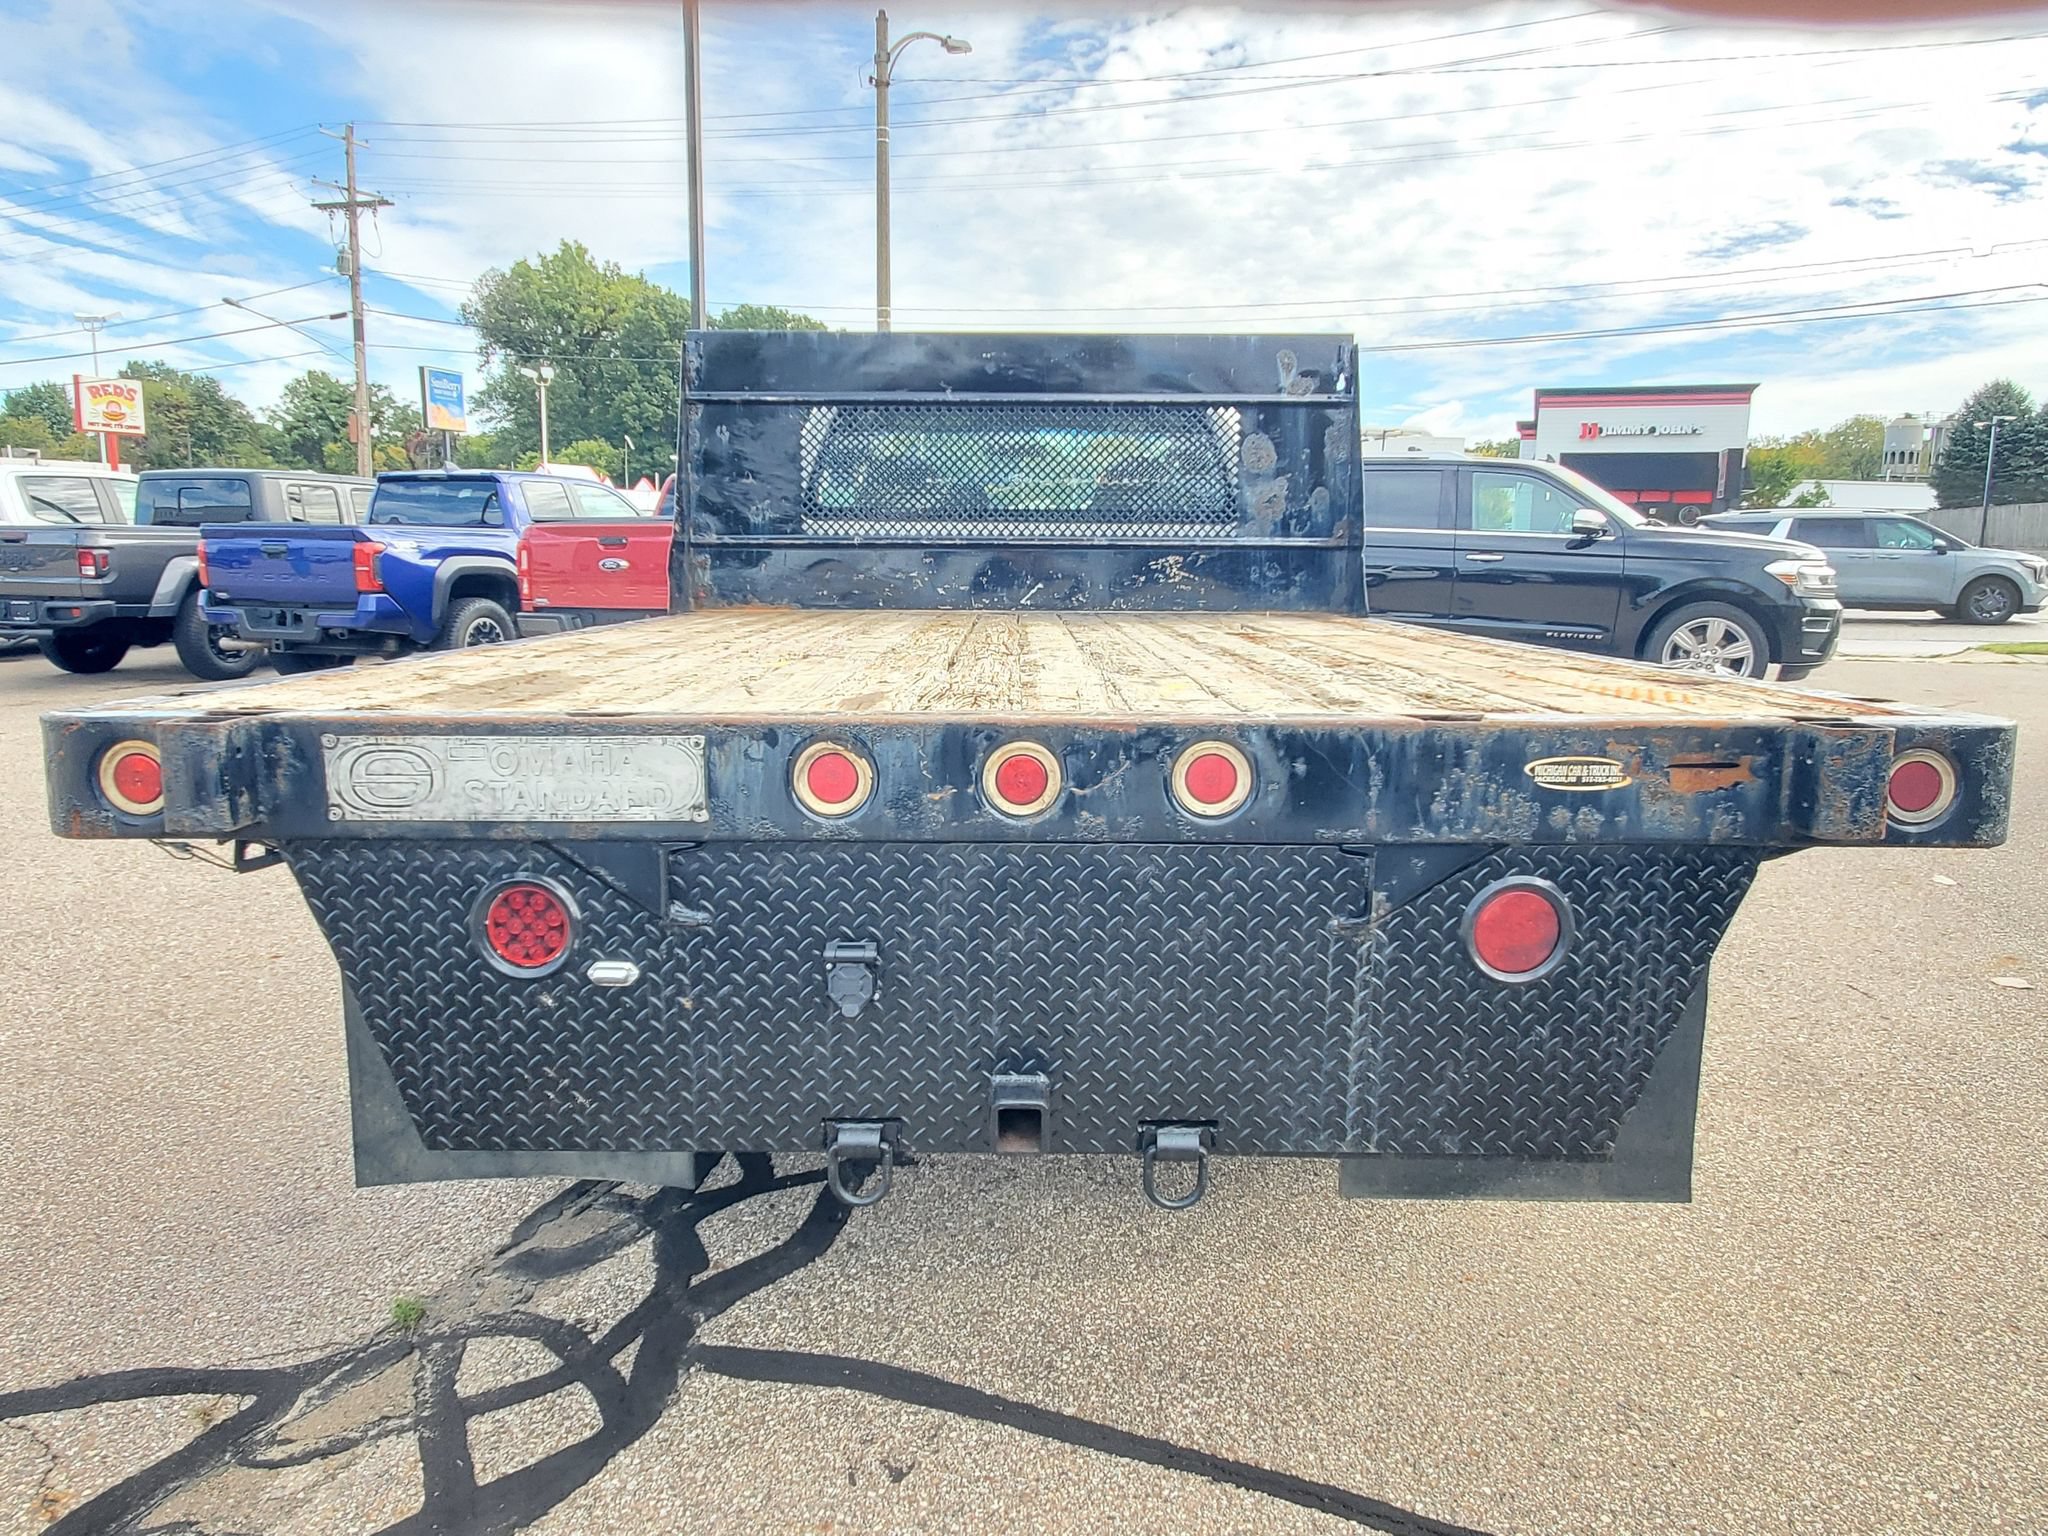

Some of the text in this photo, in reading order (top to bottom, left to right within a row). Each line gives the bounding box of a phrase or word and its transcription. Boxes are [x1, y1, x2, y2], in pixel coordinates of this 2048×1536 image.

[86, 384, 138, 401] RED'S
[1600, 424, 1651, 437] JIMMY
[1653, 424, 1705, 437] JOHN'S
[1546, 631, 1604, 640] PLATINUM
[490, 744, 638, 777] OMAHA
[1534, 765, 1567, 776] MICHIGAN
[1568, 765, 1582, 776] CAR
[1589, 765, 1610, 776] TRUCK
[464, 779, 674, 812] STANDARD
